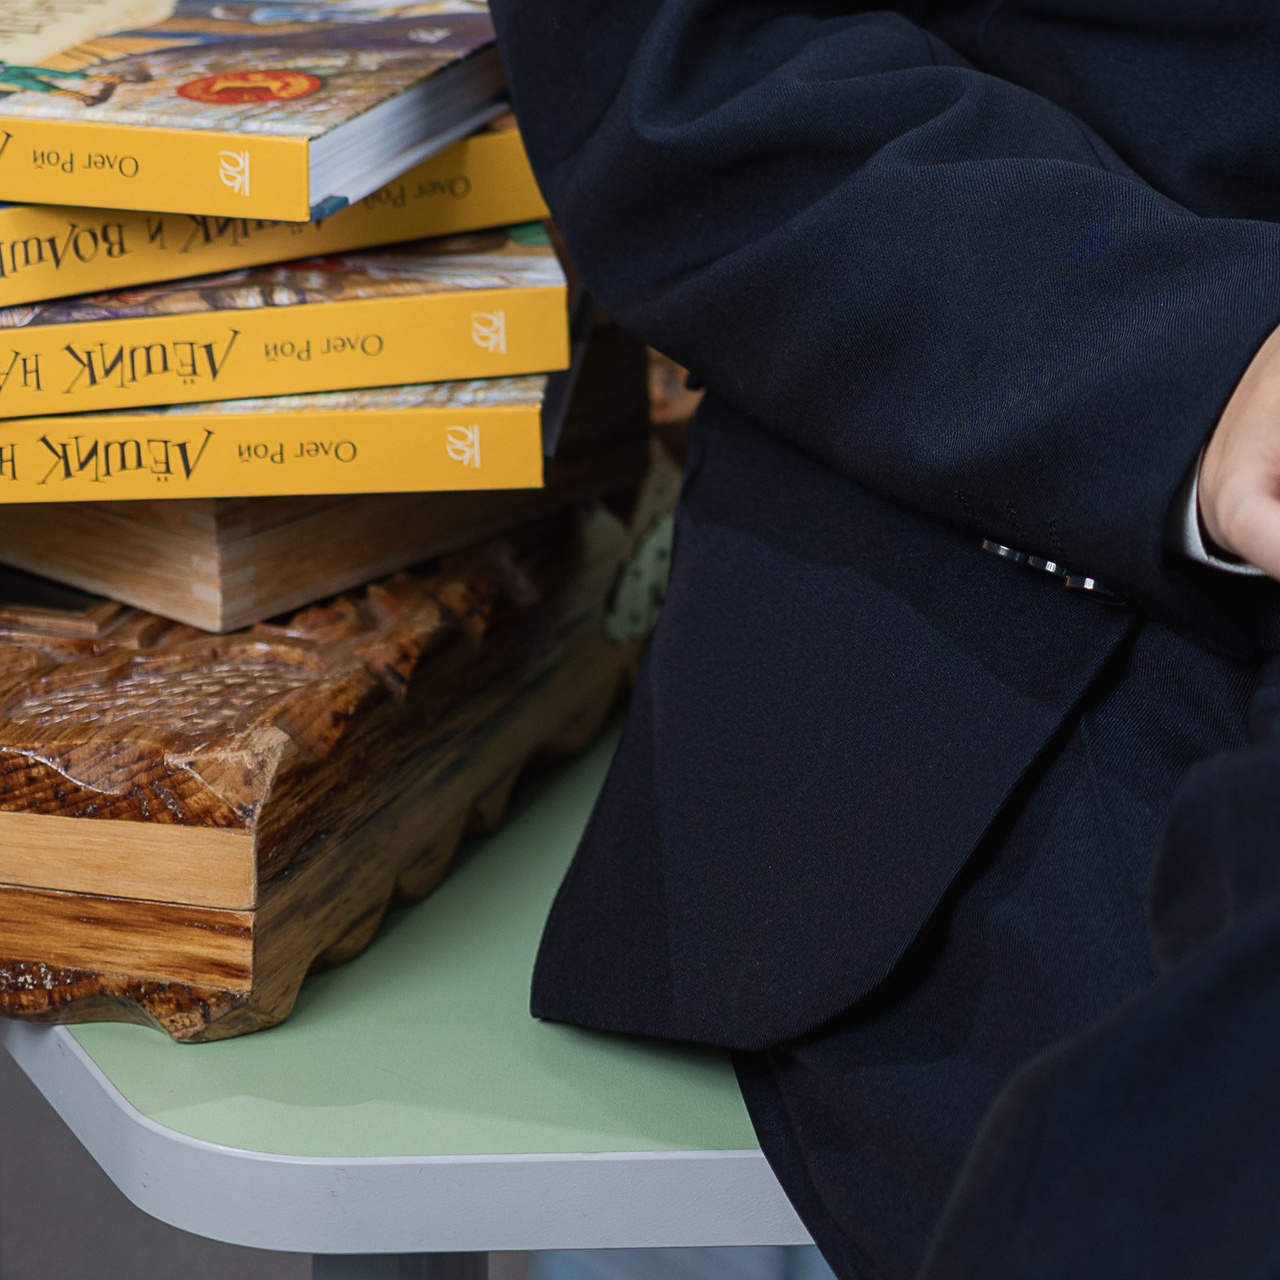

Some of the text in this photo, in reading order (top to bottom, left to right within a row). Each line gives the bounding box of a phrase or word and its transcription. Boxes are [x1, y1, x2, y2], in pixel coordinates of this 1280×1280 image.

[32, 149, 139, 178] Олег Рой
[264, 339, 311, 363] Рой
[321, 333, 384, 357] Олег
[61, 328, 242, 394] ЛЁШИК
[36, 428, 215, 485] ЛЁШИК
[237, 441, 285, 464] Рой
[294, 440, 357, 463] Олег
